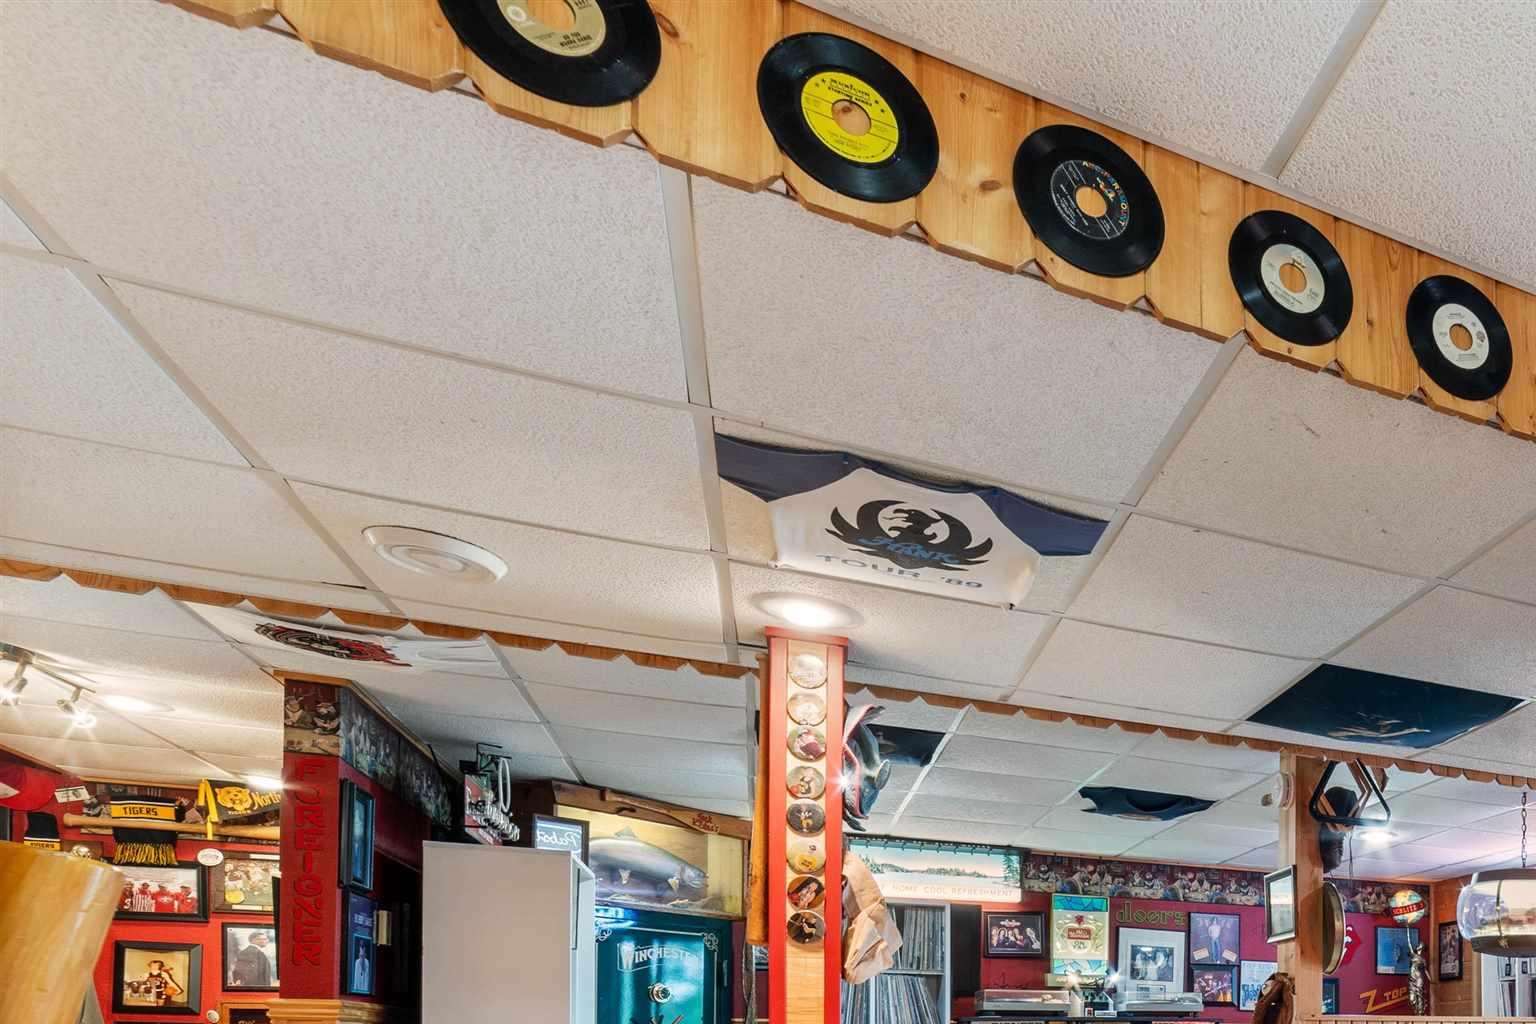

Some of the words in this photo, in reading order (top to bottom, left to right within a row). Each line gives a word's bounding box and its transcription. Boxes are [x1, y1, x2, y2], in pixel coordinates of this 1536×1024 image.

[816, 555, 921, 579] TOUR
[122, 805, 159, 817] TIGERS
[291, 757, 327, 968] FOREIGNER
[1383, 986, 1408, 1001] TOP
